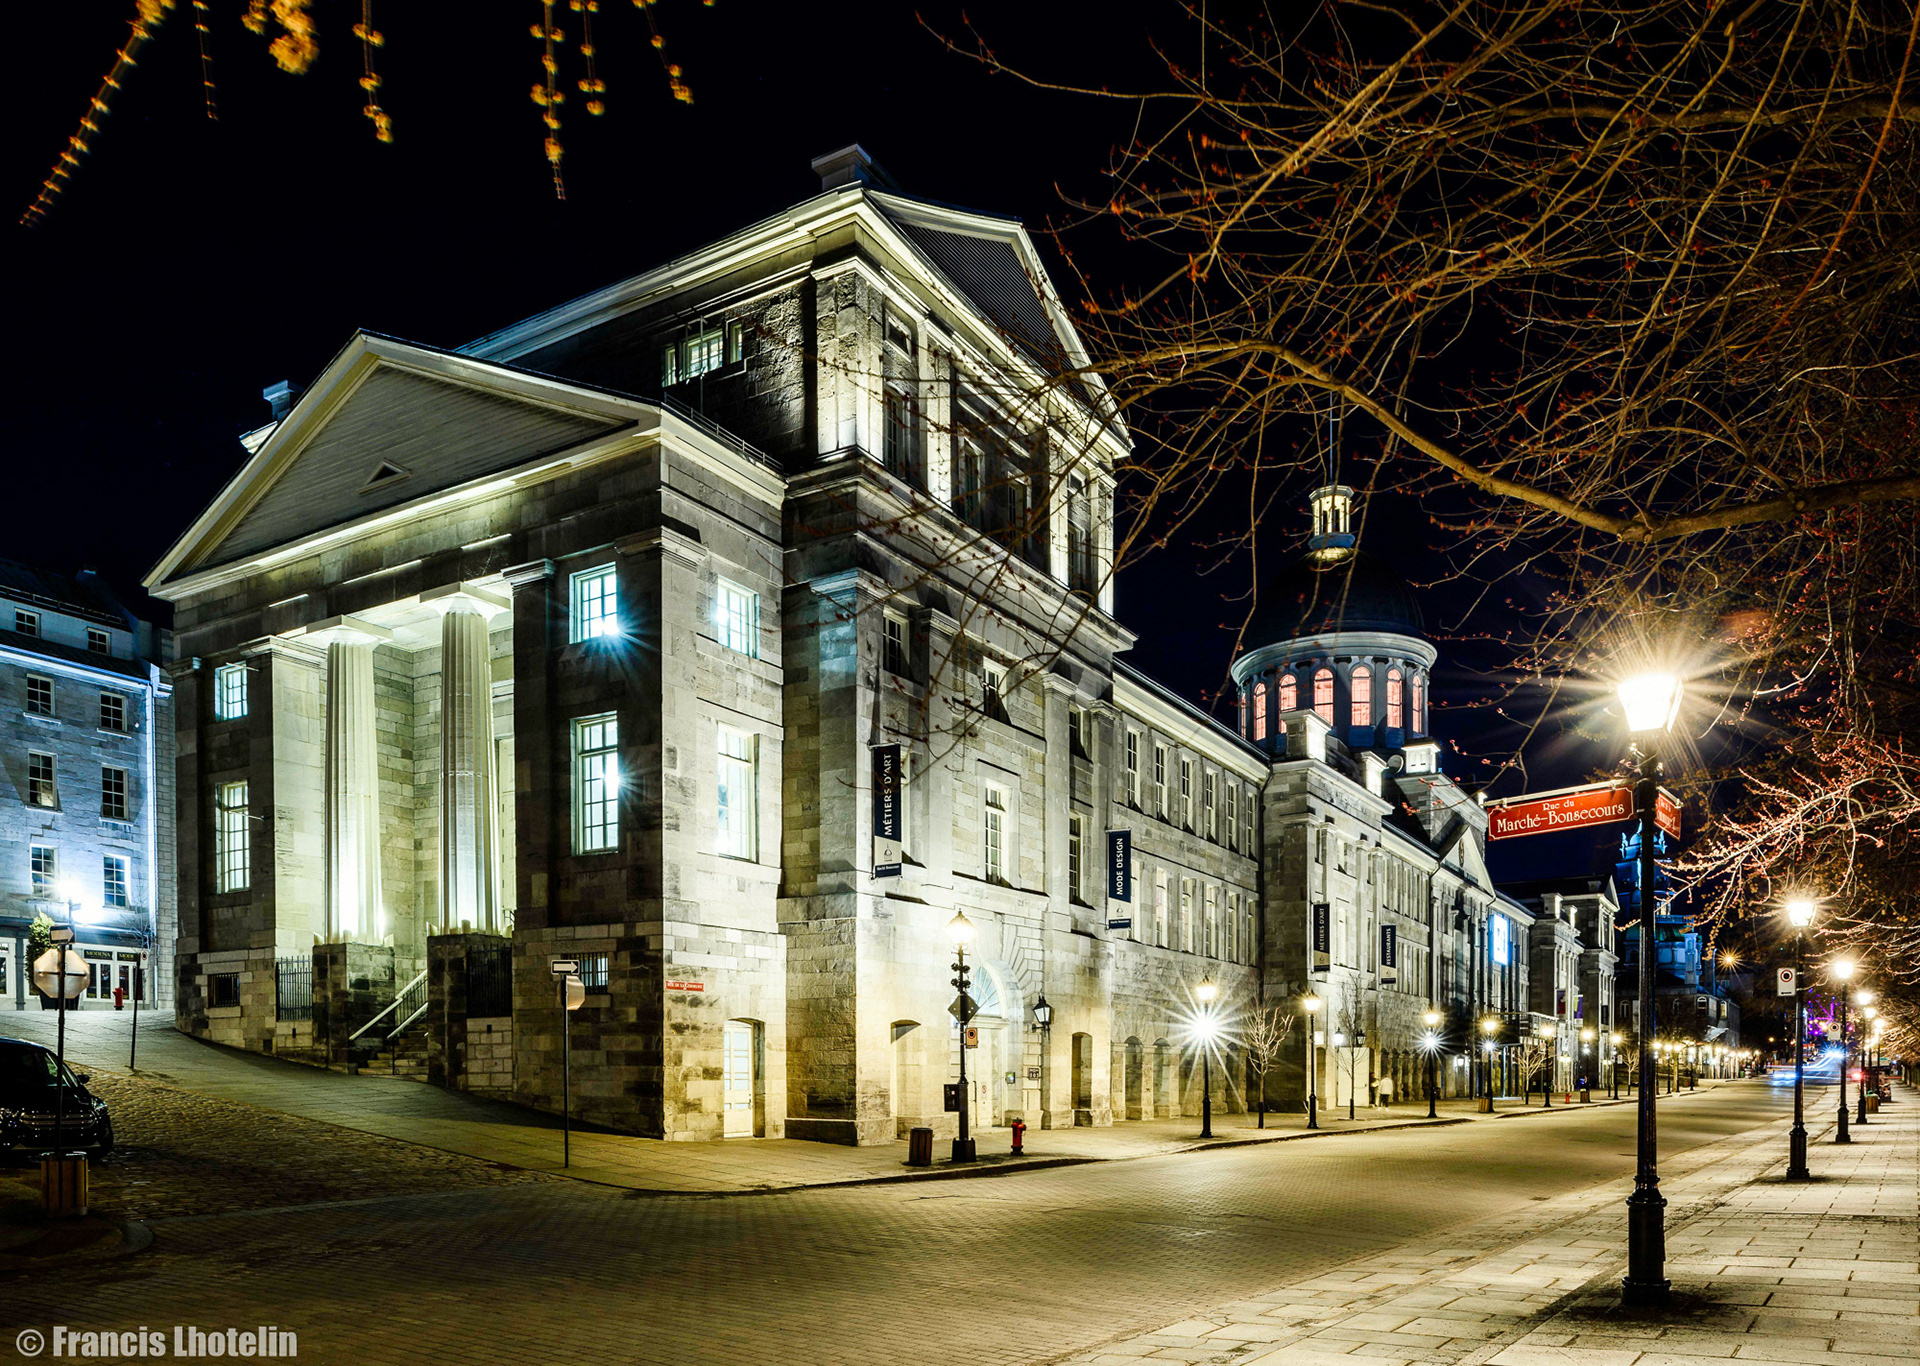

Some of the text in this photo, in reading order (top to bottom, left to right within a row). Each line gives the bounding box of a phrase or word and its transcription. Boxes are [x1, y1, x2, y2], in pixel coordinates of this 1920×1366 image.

[882, 788, 892, 836] MÉTIERS
[1496, 803, 1625, 833] Marché-Bonsecours
[1542, 799, 1575, 811] Rue du
[1116, 838, 1124, 896] MODE DESIGN
